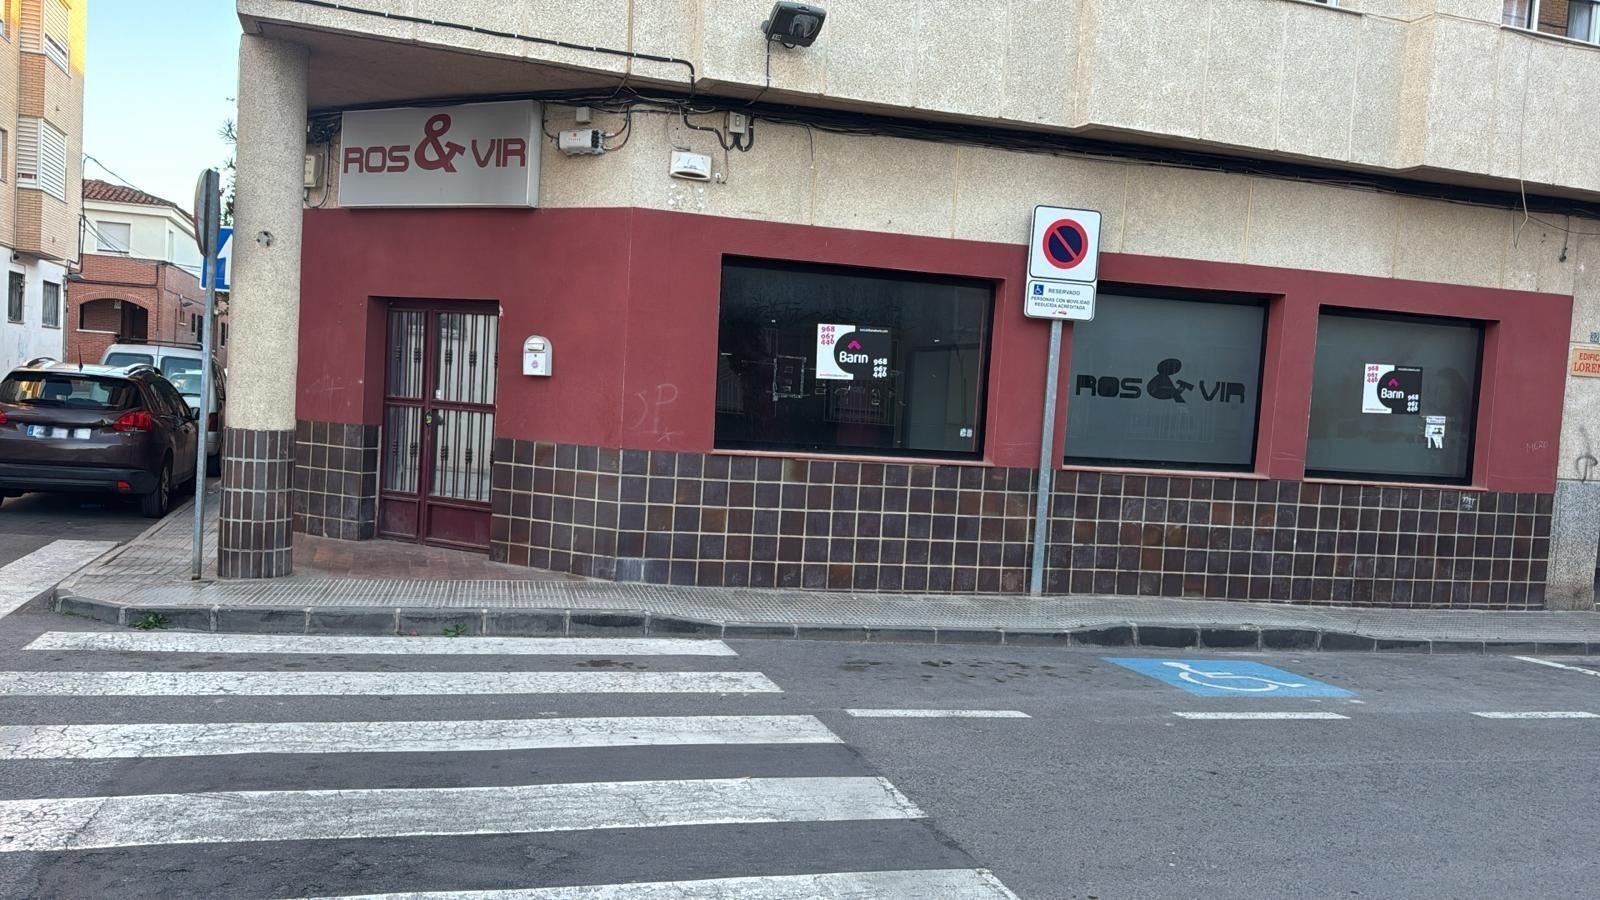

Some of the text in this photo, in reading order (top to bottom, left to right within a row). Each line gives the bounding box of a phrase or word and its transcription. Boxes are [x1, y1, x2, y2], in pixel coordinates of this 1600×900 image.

[343, 113, 526, 173] ROS & VIR
[1048, 288, 1081, 296] RESERVADO
[839, 351, 868, 363] Barin
[1075, 374, 1142, 399] ROS
[1199, 380, 1246, 404] VIR
[1381, 388, 1404, 399] Barin
